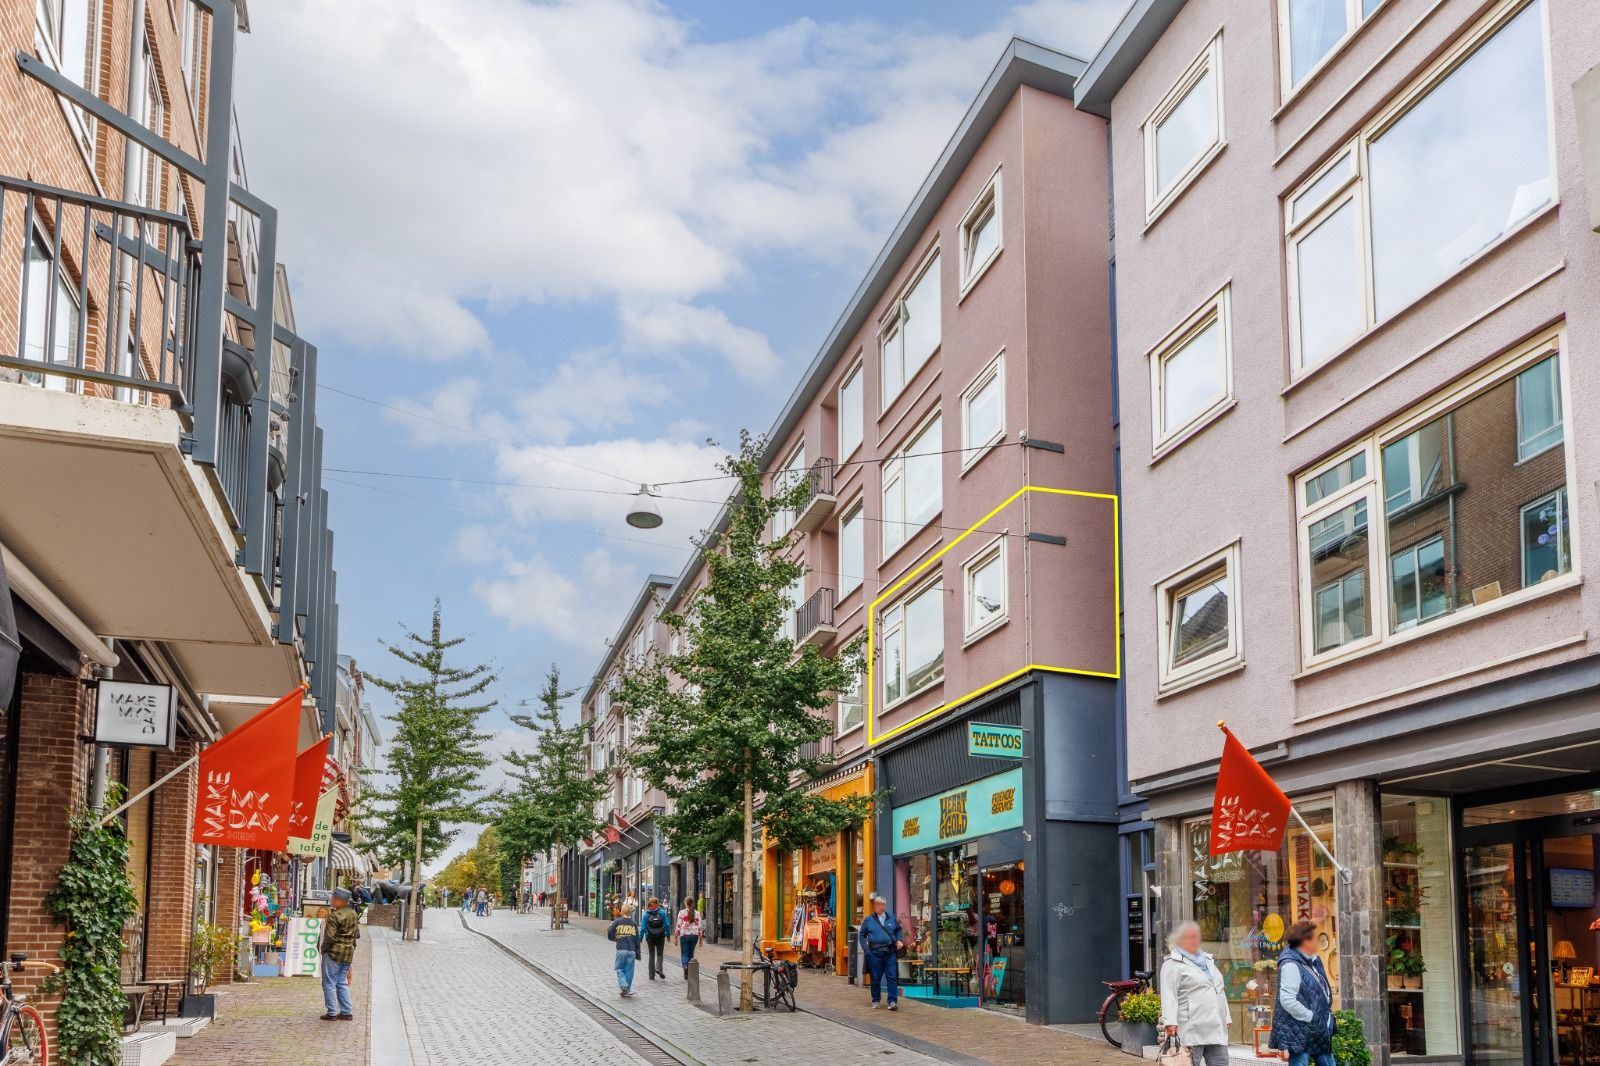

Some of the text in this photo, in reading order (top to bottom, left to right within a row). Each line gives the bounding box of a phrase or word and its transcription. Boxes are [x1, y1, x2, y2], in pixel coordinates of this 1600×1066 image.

[111, 692, 157, 707] MAKE
[972, 731, 1022, 750] TATTOOS
[202, 770, 230, 838] MAKE
[231, 788, 270, 811] MY
[939, 790, 967, 826] HEART
[228, 809, 279, 833] DAY
[315, 821, 329, 831] de
[944, 812, 967, 838] GOLD
[1217, 796, 1239, 849] MAKE
[1238, 808, 1270, 822] MY
[1234, 822, 1277, 838] DAY
[300, 843, 326, 854] tafel
[1193, 830, 1208, 901] MAKE
[298, 917, 320, 973] open
